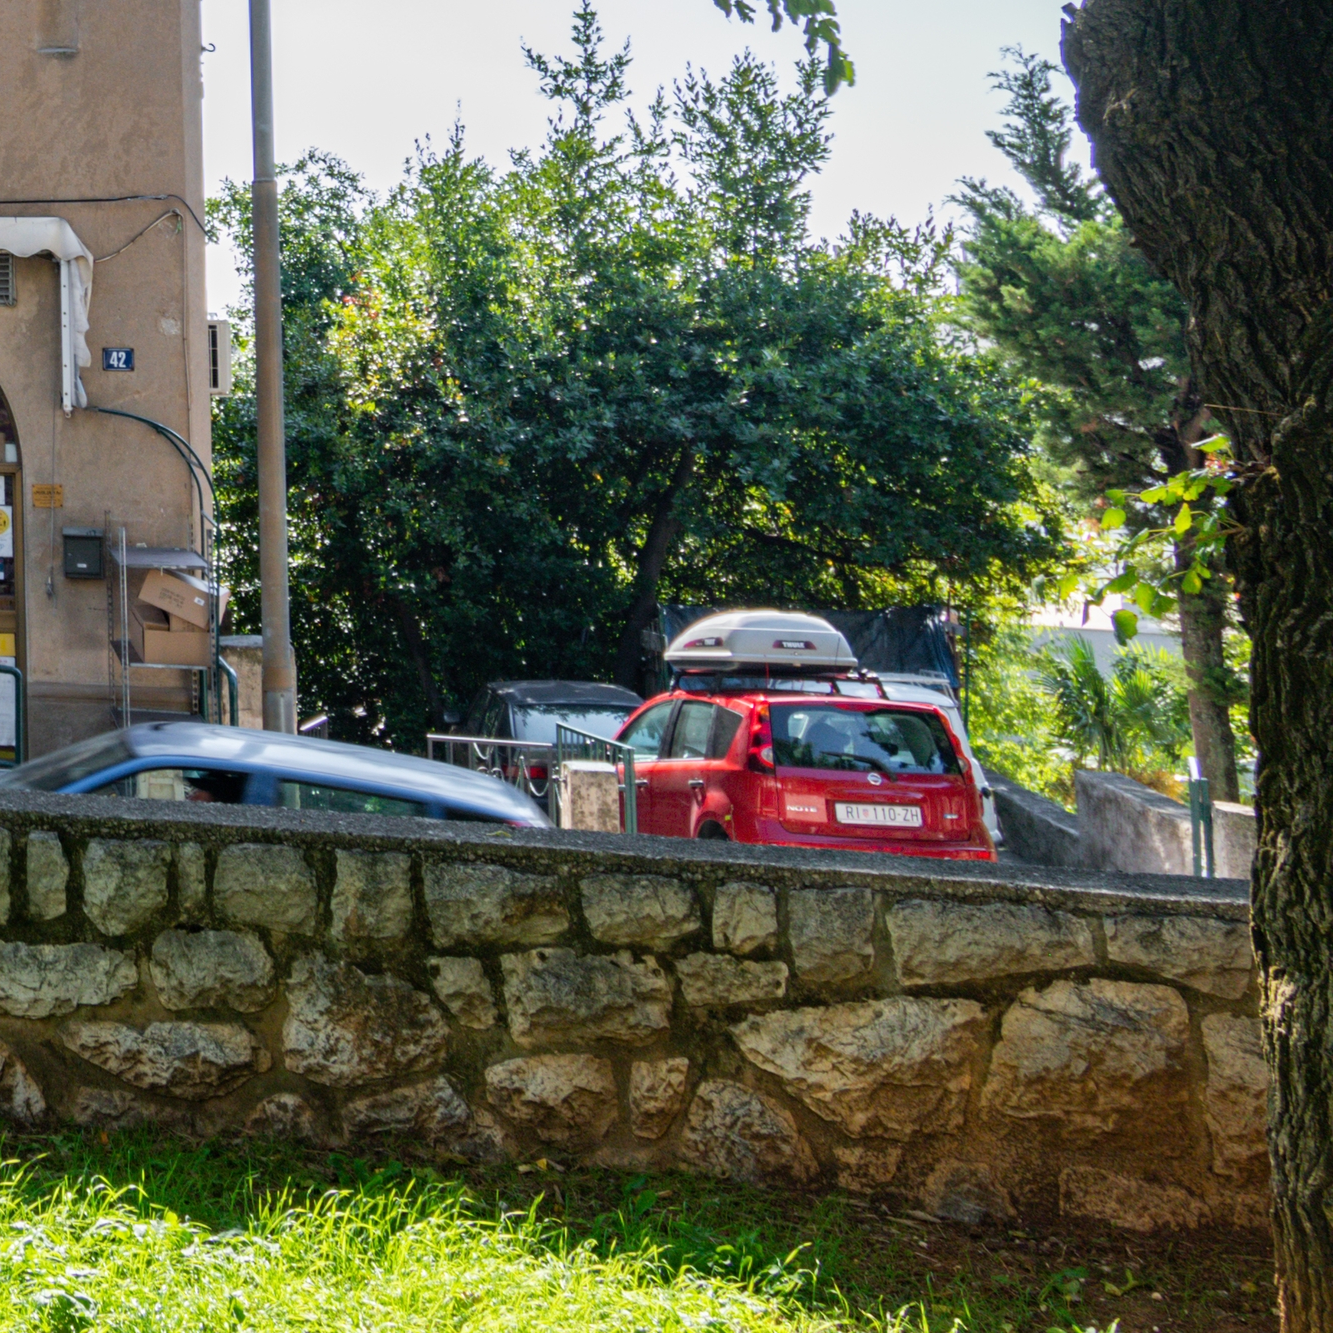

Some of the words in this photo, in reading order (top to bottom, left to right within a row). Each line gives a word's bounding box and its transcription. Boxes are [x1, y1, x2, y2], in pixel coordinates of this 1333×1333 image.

[109, 351, 127, 368] 42
[786, 805, 818, 813] NOTE
[845, 805, 860, 820] RI
